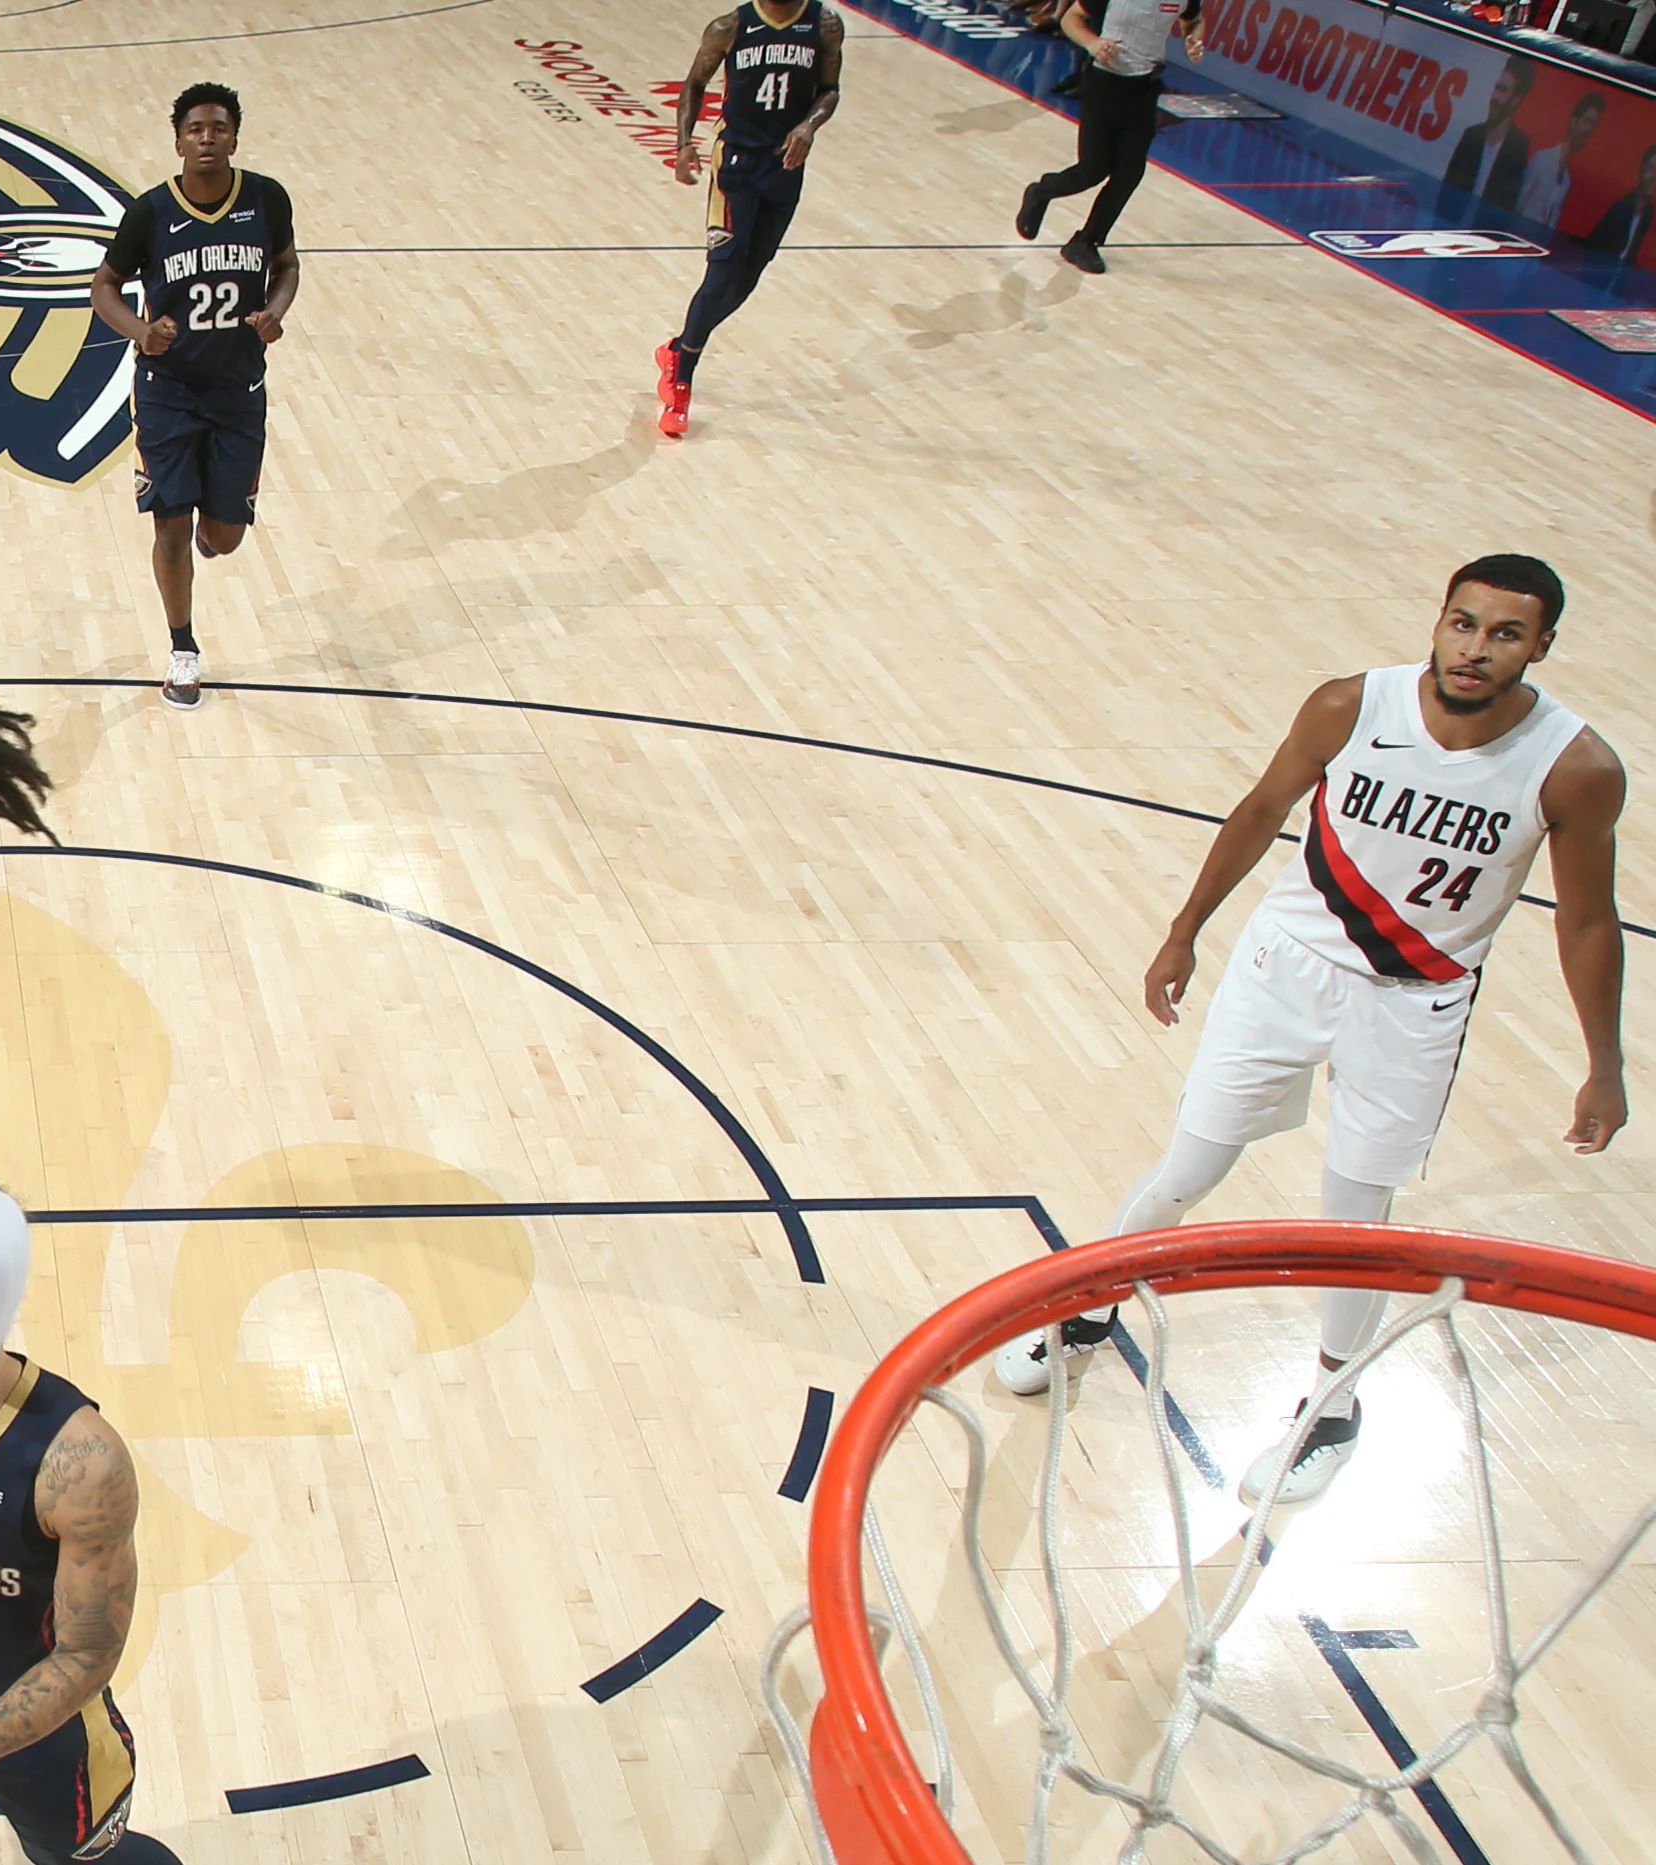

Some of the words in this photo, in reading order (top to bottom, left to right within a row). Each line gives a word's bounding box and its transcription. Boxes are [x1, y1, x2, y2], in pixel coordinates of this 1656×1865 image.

[513, 38, 659, 119] SMOOTHIE
[736, 45, 765, 70] NEW
[765, 43, 816, 69] ORLEANS
[1170, 0, 1271, 65] NAS
[1255, 5, 1468, 142] BROTHERS
[513, 80, 583, 123] CENTER
[755, 71, 790, 111] 41
[163, 248, 198, 284] NEW
[201, 244, 264, 272] ORLEANS
[188, 281, 240, 331] 22
[1339, 770, 1512, 856] BLAZERS
[1404, 857, 1484, 912] 24
